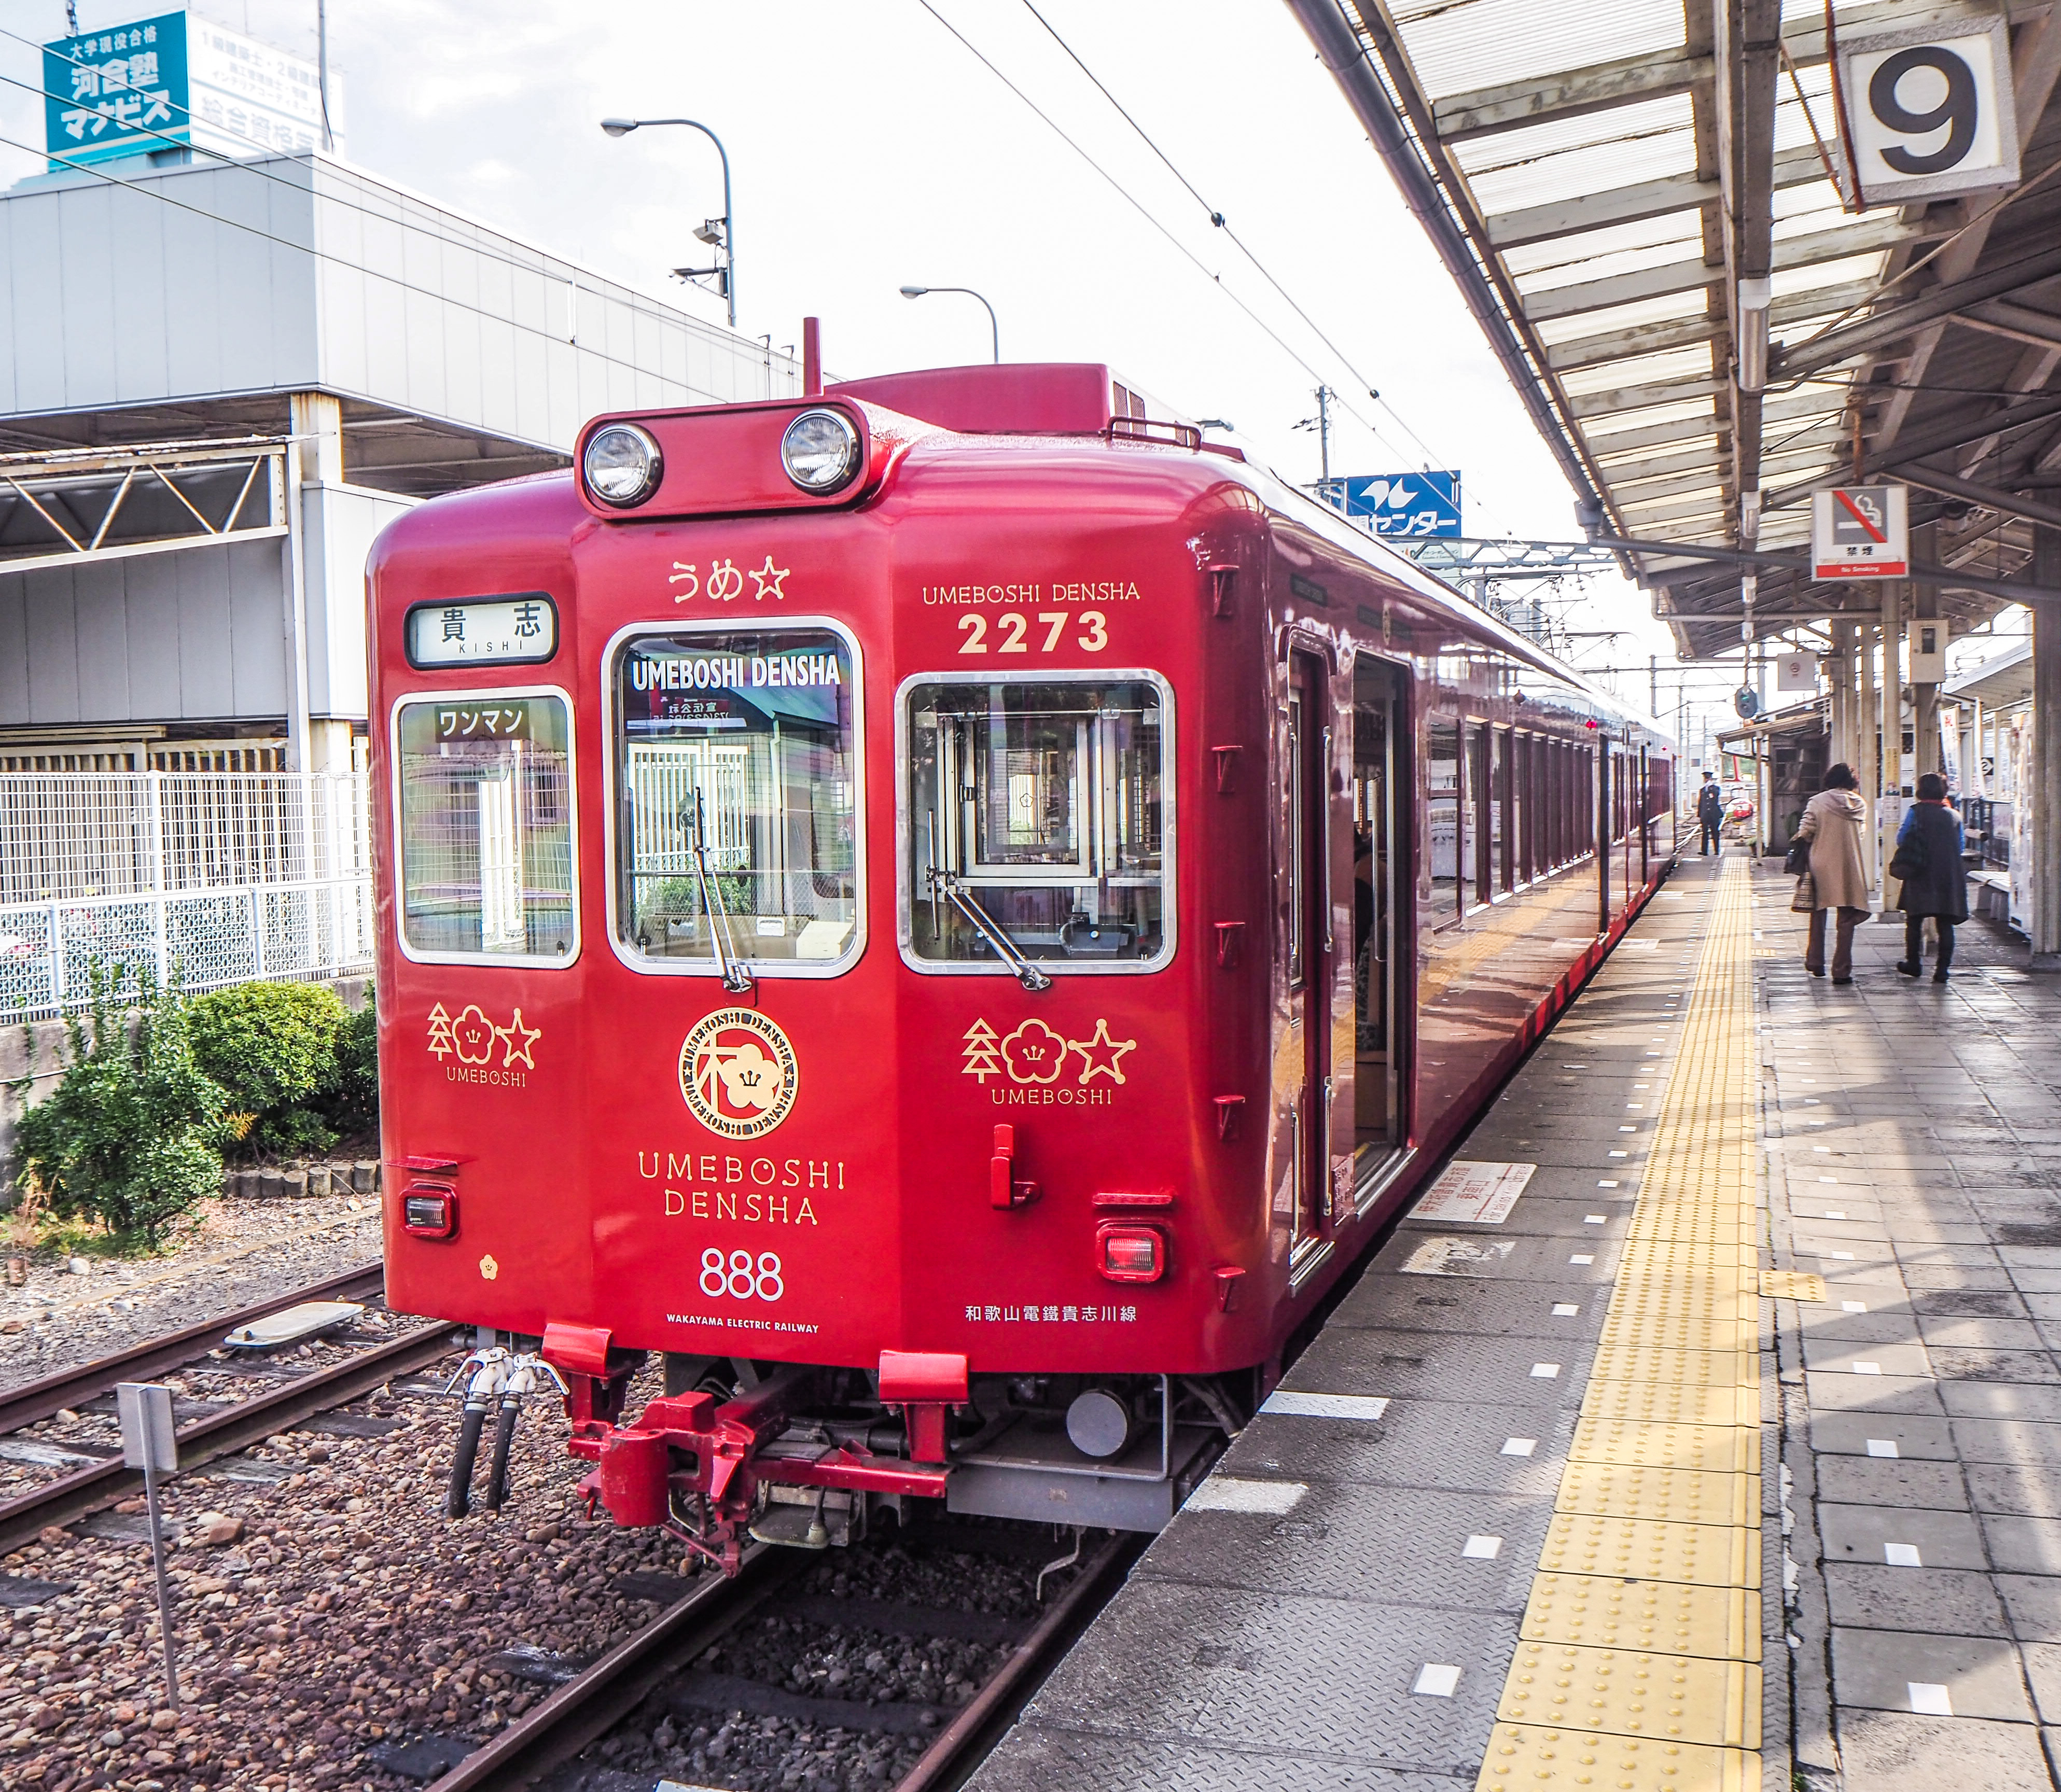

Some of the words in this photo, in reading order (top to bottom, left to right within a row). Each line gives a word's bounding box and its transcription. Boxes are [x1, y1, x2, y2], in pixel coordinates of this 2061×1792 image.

[70, 25, 157, 60] 大学現役合格
[71, 51, 159, 101] 河合塾
[61, 89, 172, 140] マナビス
[1869, 46, 1978, 175] 9
[1846, 545, 1873, 556] 禁煙
[923, 584, 1040, 605] UMEBOSHI
[1052, 582, 1140, 603] DENSHA
[459, 640, 523, 654] KISHI
[957, 610, 1109, 654] 2273
[632, 657, 744, 691] UMEBOSHI
[751, 654, 841, 687] DENSHA
[440, 709, 523, 737] ワンマン
[1981, 761, 1988, 772] 2
[683, 1012, 740, 1063] UMEBOSHI
[750, 1016, 793, 1069] DENSHA
[447, 1066, 526, 1087] UMEBOSHI
[684, 1081, 742, 1136] UMEBOSHI
[751, 1088, 793, 1132] DENSHA
[991, 1089, 1112, 1105] UMEBOSHI
[638, 1151, 844, 1189] UMEBOSHI
[664, 1188, 818, 1225] DENSHA
[699, 1248, 785, 1302] 888
[666, 1313, 724, 1326] WAKAYAMA
[727, 1318, 771, 1331] ELECTRIC
[774, 1322, 819, 1334] RAILWAY
[965, 1305, 1137, 1322] 和歌山電鐵貴志川線
